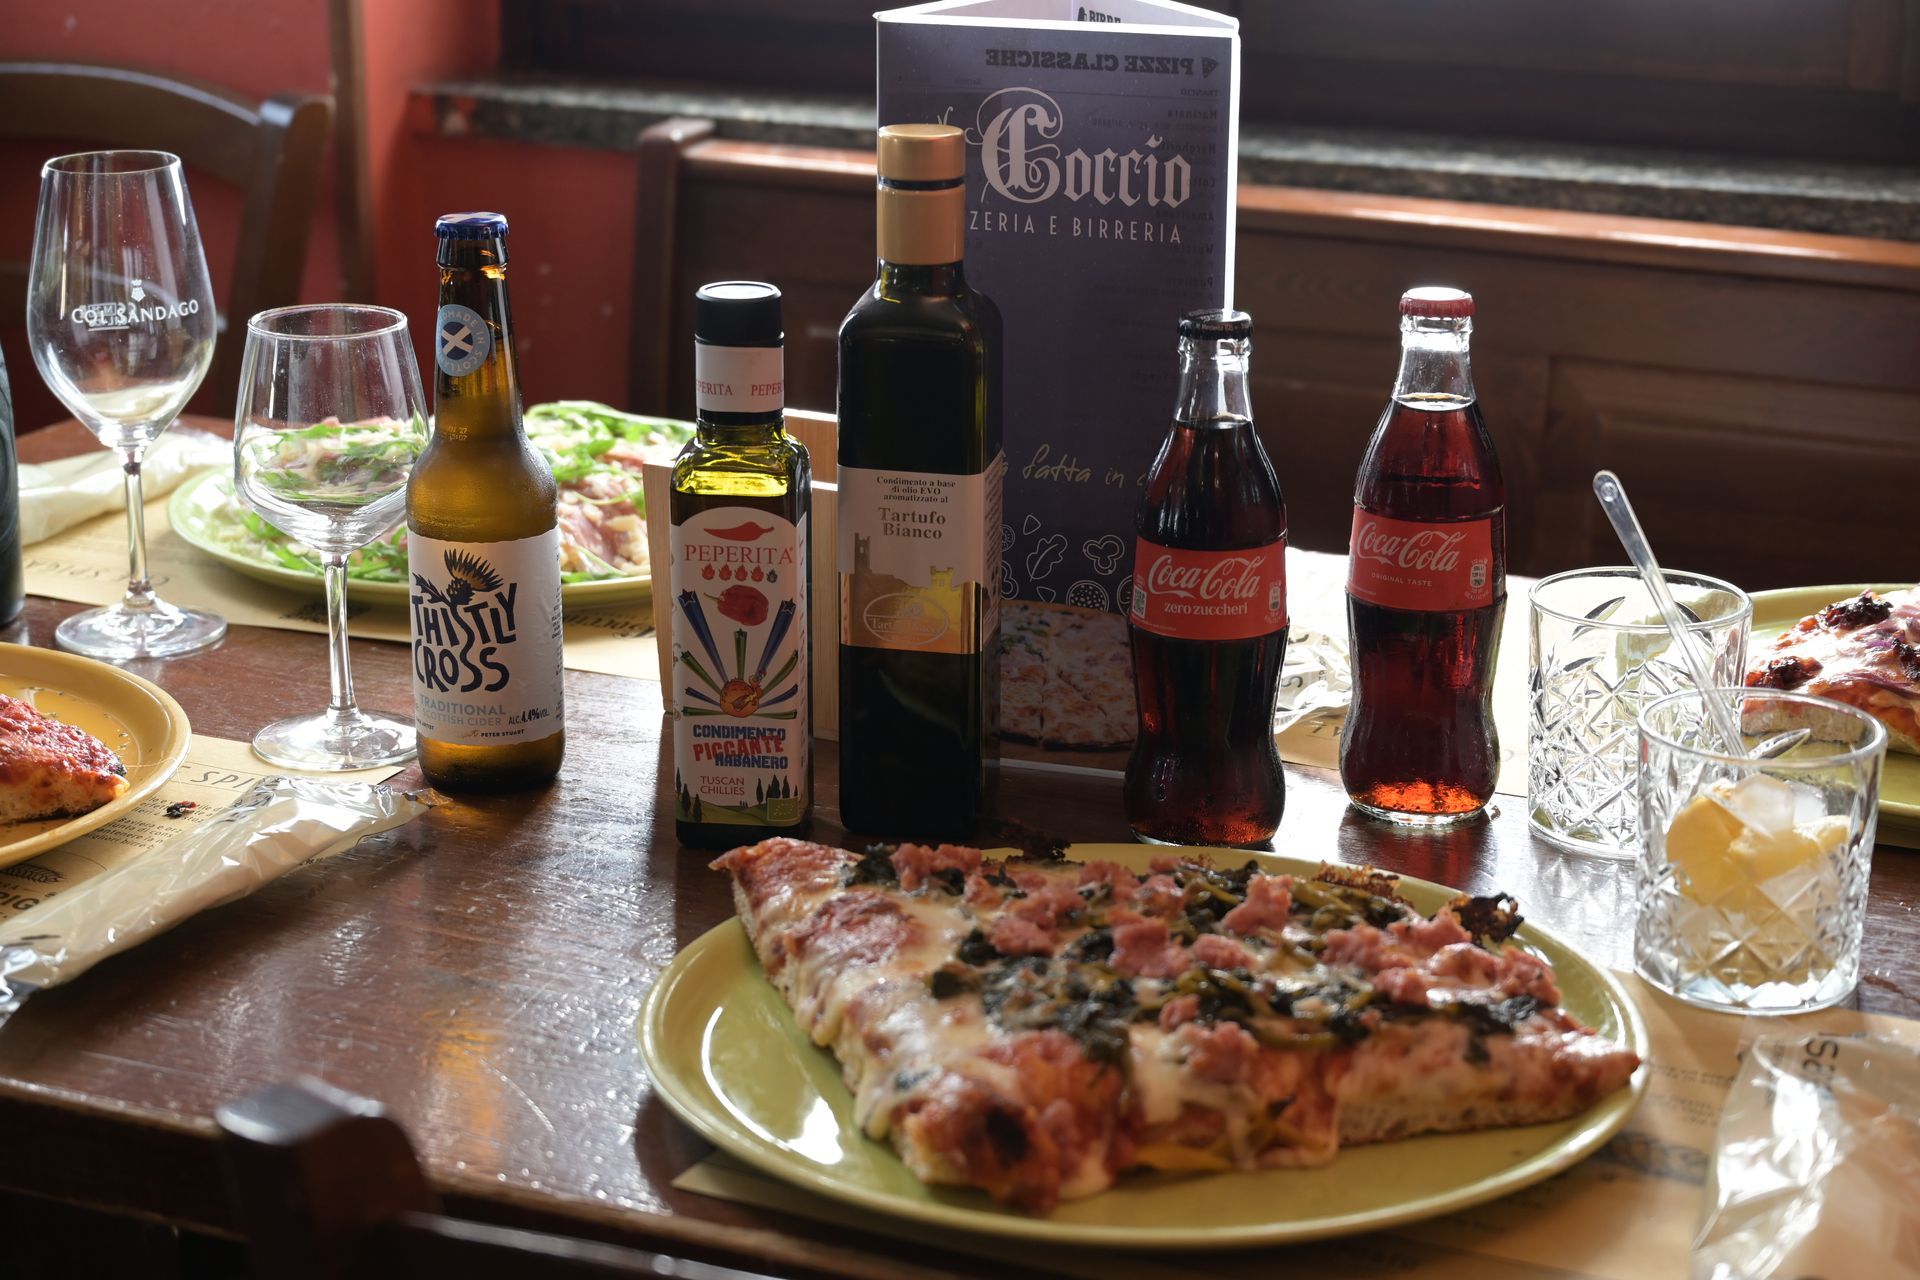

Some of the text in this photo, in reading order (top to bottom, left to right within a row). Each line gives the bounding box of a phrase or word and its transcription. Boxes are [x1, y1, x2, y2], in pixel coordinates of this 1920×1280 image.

[974, 87, 1191, 208] Coccio
[970, 211, 1182, 244] ZERIA E BIRRERIA
[72, 307, 109, 323] COL
[116, 299, 199, 323] SANDAGO
[876, 476, 927, 487] Condimento
[937, 479, 956, 488] base
[891, 485, 941, 495] di olio EVO
[883, 494, 938, 503] aromatizzato
[878, 507, 946, 525] Tartufo
[883, 522, 942, 540] Bianco
[684, 544, 793, 564] PEPERITA
[1357, 521, 1468, 571] Coca-Cola
[1148, 554, 1266, 600] Coca-Cola
[1371, 571, 1433, 587] ORIGINAL TASTE
[412, 583, 518, 646] THISTLY
[1164, 602, 1248, 616] zero zuccheri
[414, 639, 510, 693] CROSS
[420, 694, 506, 716] TRADITIONAL
[467, 716, 501, 727] CIDER
[501, 729, 525, 737] STUART
[693, 724, 786, 741] CONDIMENTO
[693, 735, 784, 762] PICCANTE
[714, 753, 788, 769] HABANERO
[700, 776, 745, 786] TUSCAN
[700, 785, 745, 796] CHILLIES
